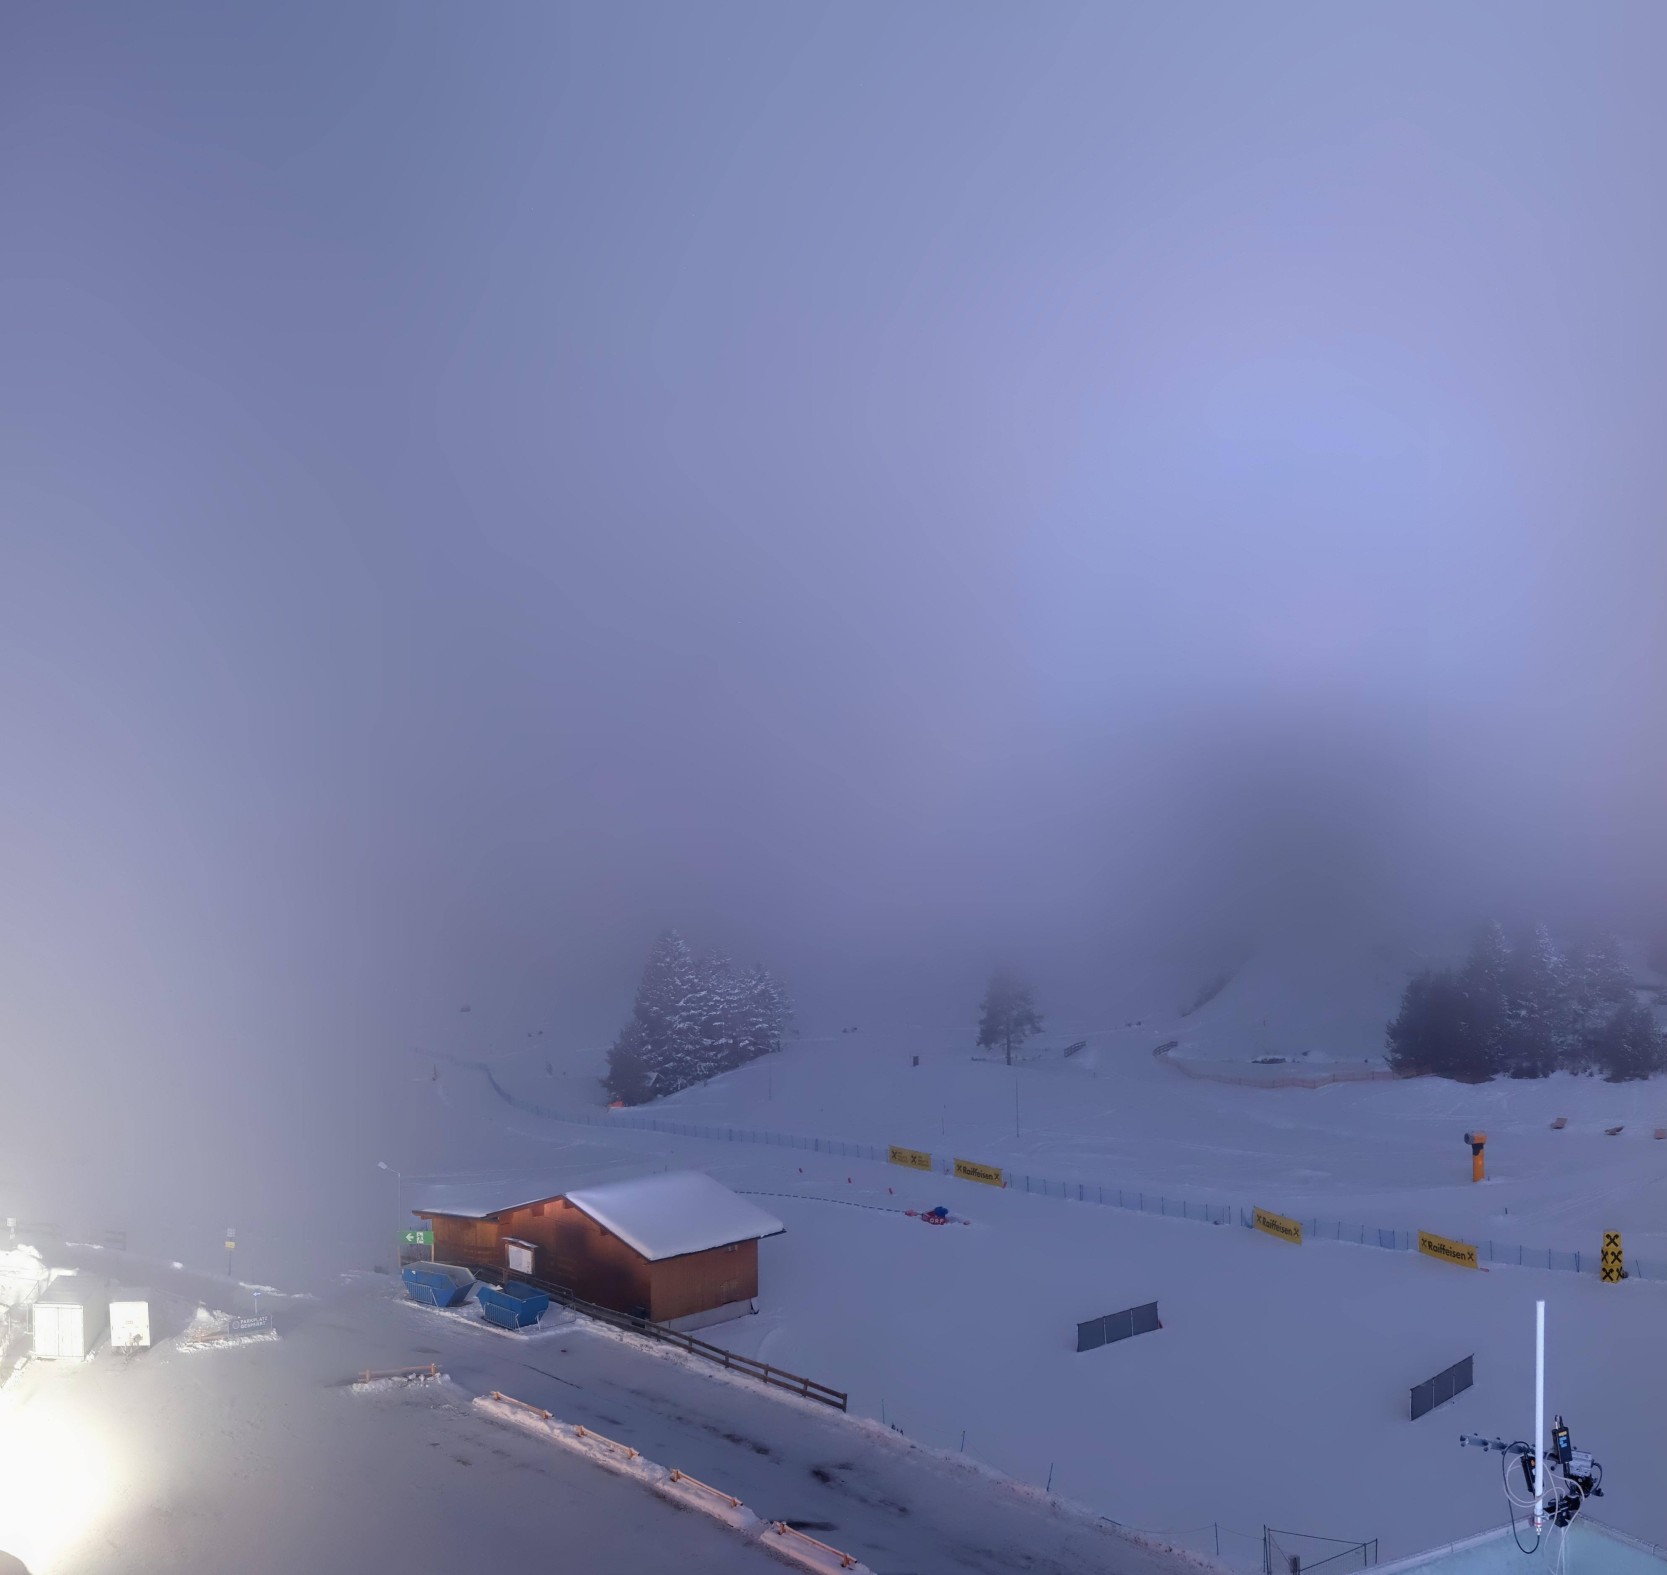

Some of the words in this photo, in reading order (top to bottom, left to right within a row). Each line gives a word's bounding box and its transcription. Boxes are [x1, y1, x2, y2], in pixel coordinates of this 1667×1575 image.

[962, 1167, 993, 1180] Raiffeisen
[1262, 1217, 1293, 1236] Raiffeisen
[1428, 1240, 1466, 1260] Raiffeisen
